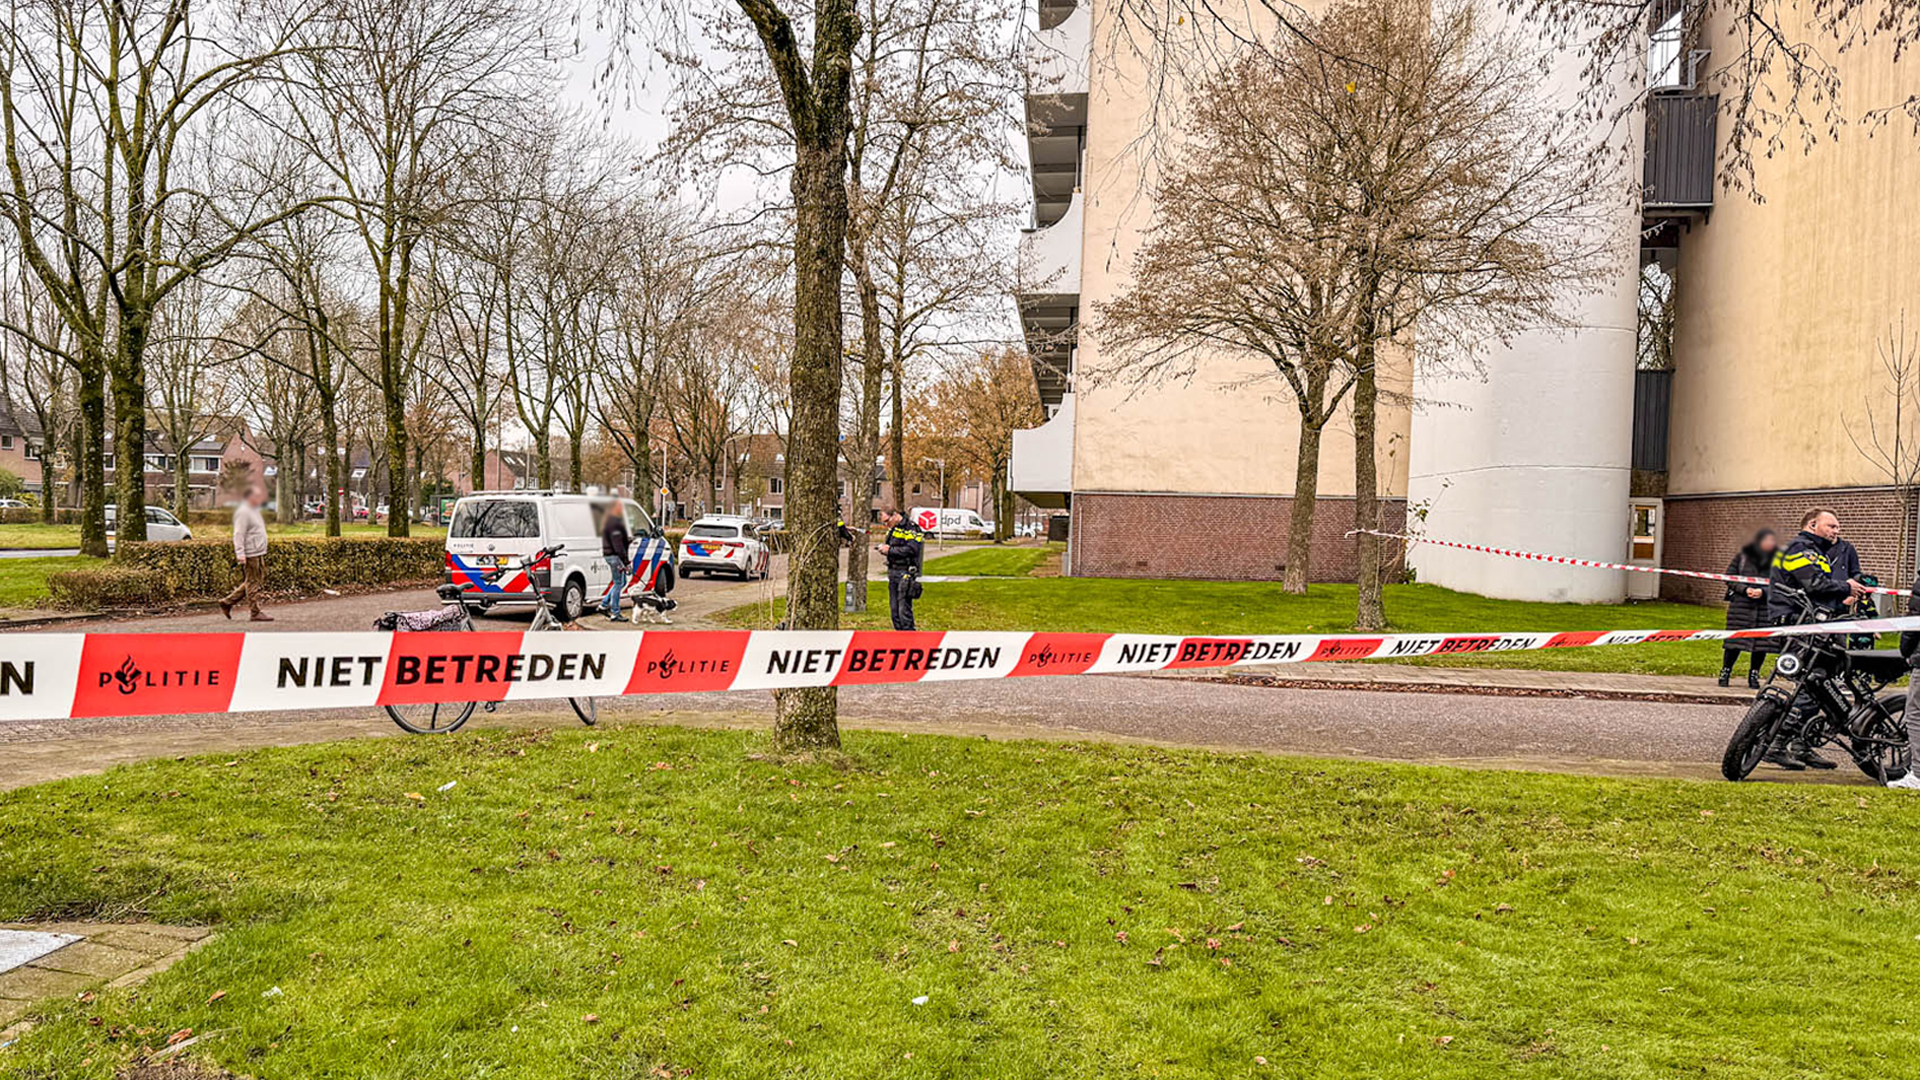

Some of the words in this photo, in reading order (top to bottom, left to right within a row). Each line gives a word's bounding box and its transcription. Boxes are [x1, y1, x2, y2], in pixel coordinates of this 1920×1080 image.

[941, 515, 961, 526] dpd
[1117, 643, 1177, 664] NIET
[1180, 641, 1302, 662] BETREDEN
[1389, 639, 1441, 655] NIET
[1440, 637, 1537, 654] BETREDEN
[277, 655, 383, 688] NIET
[395, 653, 607, 685] BETREDEN
[766, 649, 843, 674] NIET
[847, 647, 1001, 672] BETREDEN
